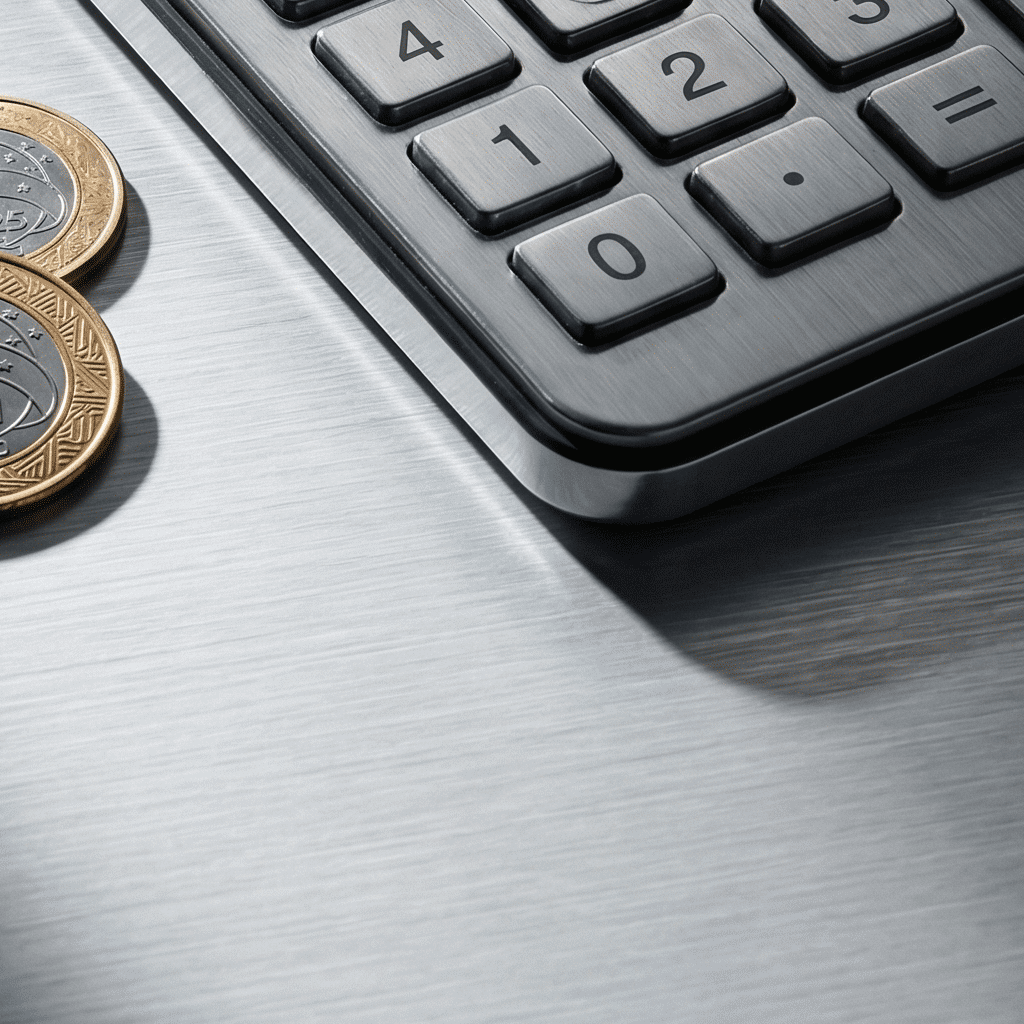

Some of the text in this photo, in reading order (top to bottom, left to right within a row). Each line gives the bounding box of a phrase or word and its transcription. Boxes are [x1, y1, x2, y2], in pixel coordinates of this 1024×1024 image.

[398, 20, 444, 62] 4
[661, 51, 728, 101] 2
[492, 124, 542, 166] 1
[587, 232, 647, 280] 0
